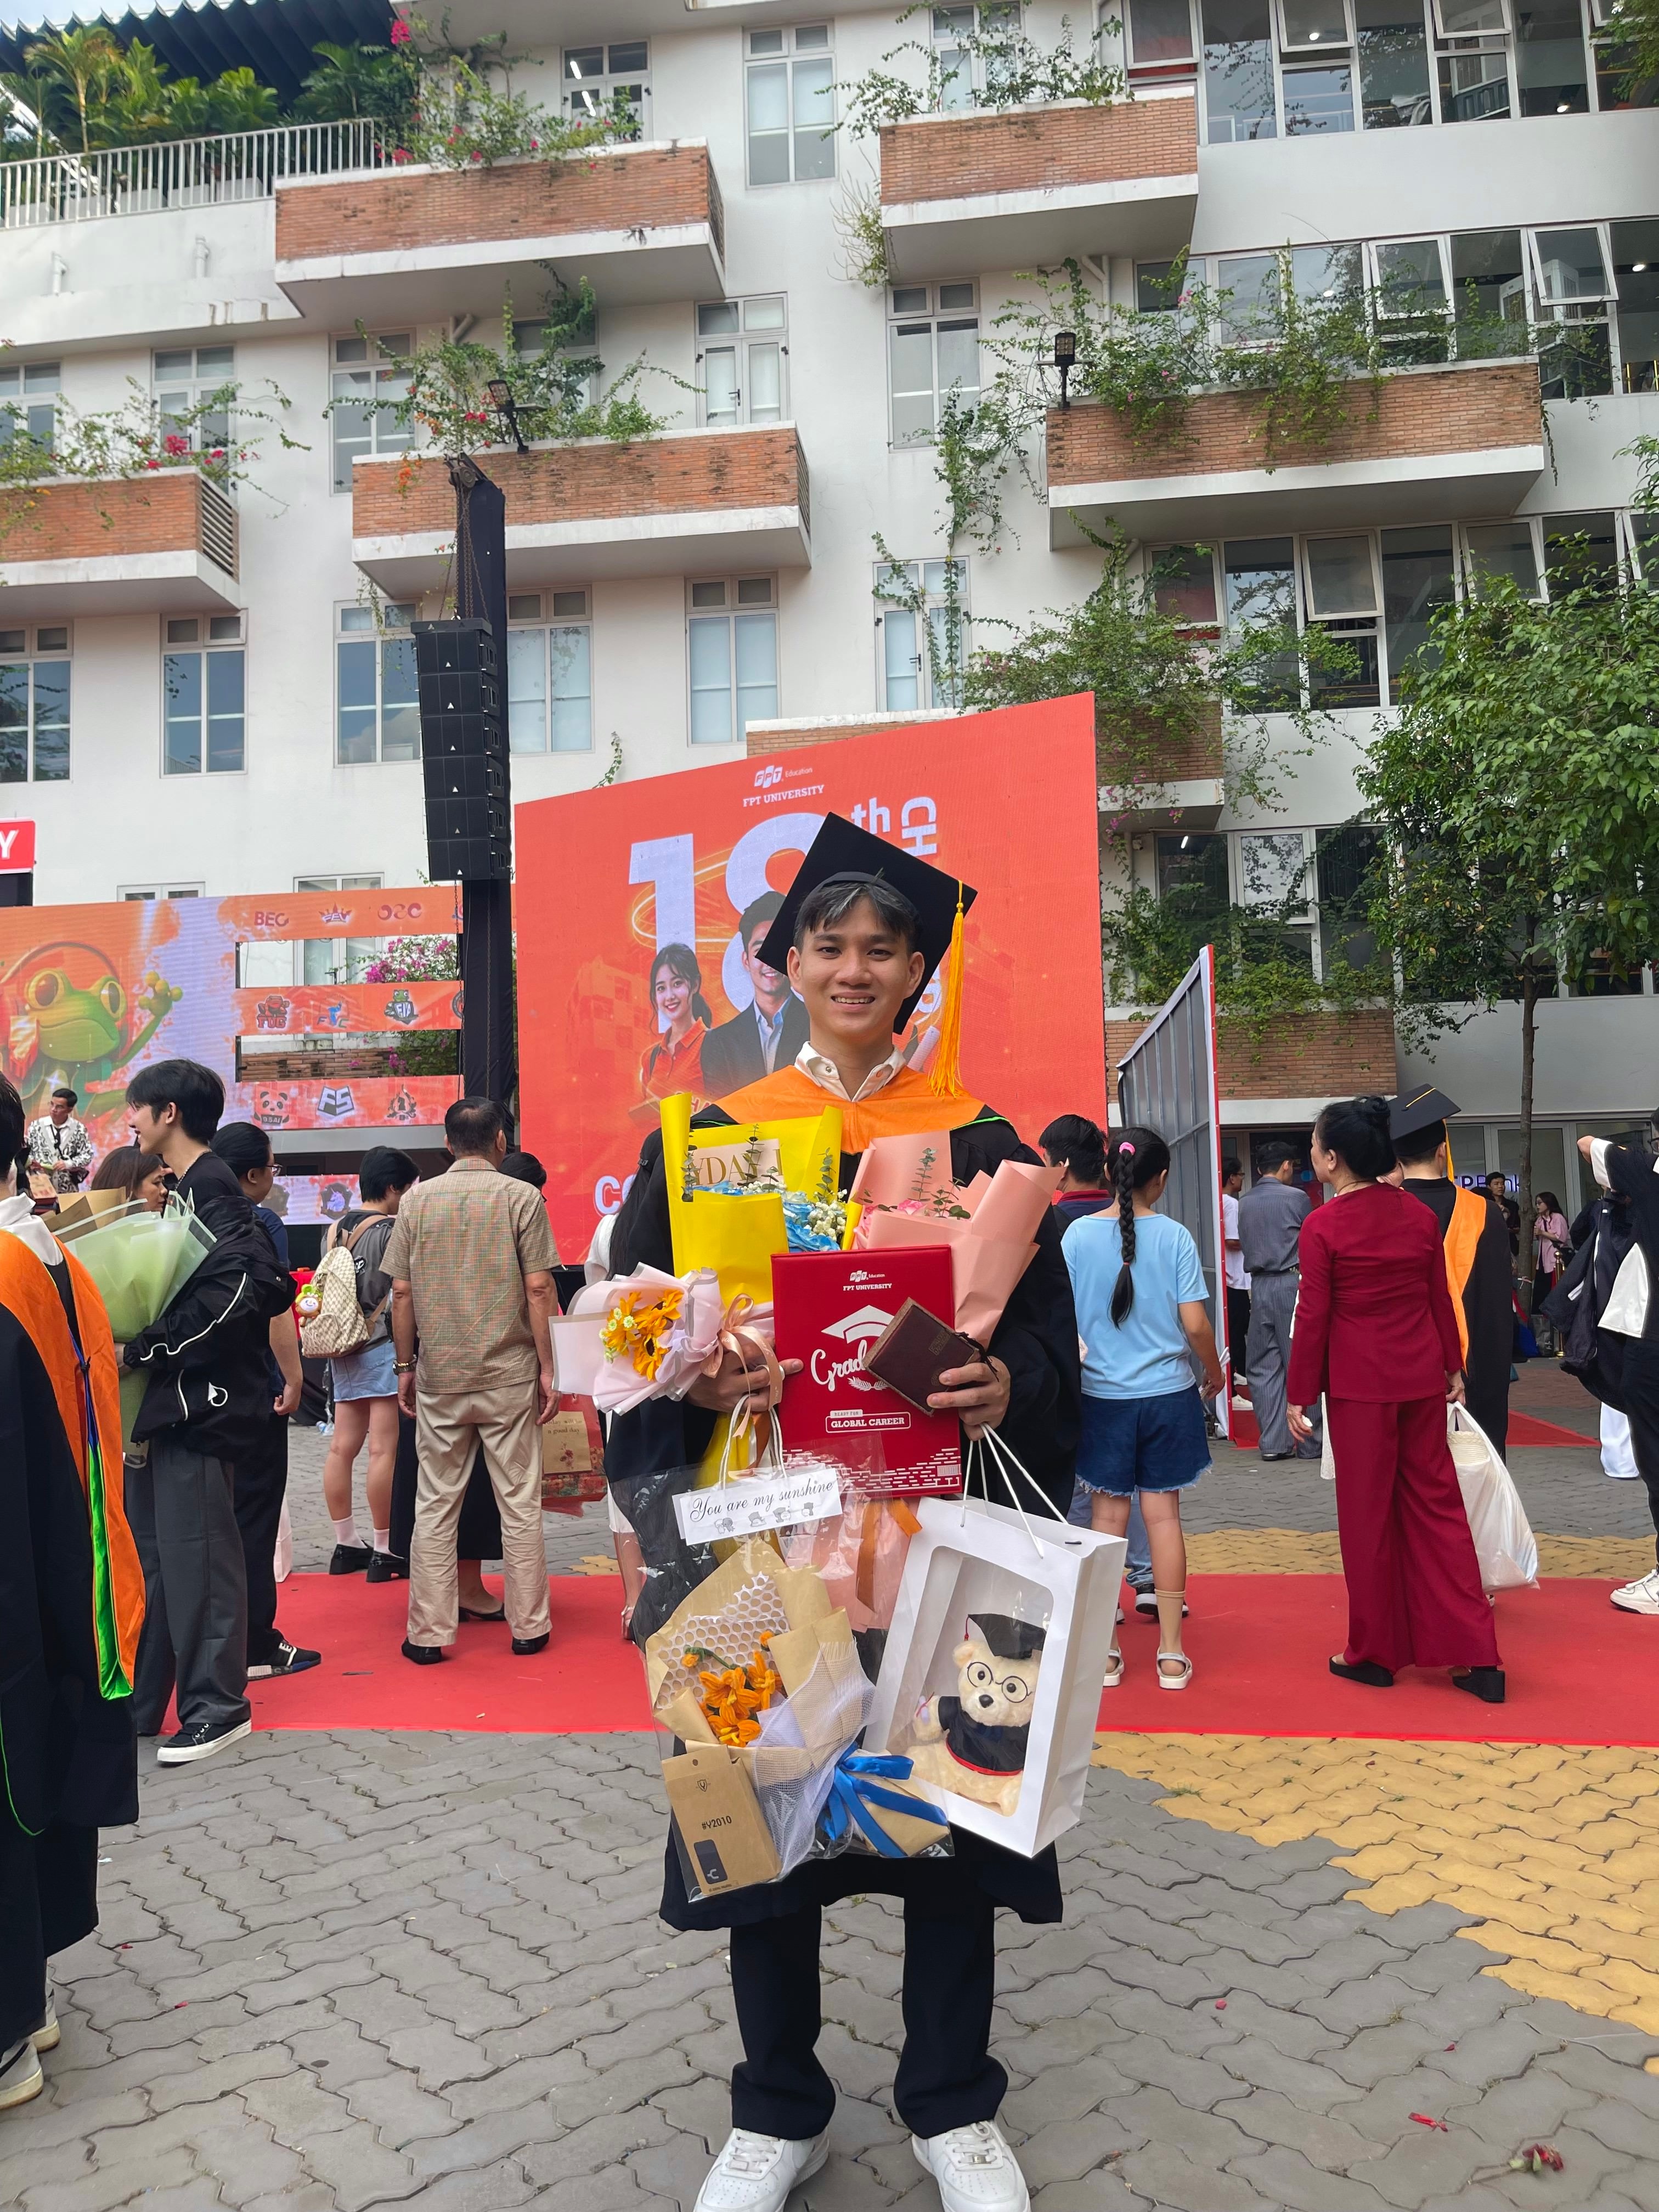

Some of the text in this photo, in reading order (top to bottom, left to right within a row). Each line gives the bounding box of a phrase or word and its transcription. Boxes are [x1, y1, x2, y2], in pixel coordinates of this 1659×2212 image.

[754, 765, 812, 788] FPT Education
[743, 785, 824, 807] FPT UNIVERSITY
[831, 1417, 905, 1428] GLOBAL CAREER
[690, 1478, 833, 1522] You are my sunshine
[702, 1815, 732, 1830] #Y2010
